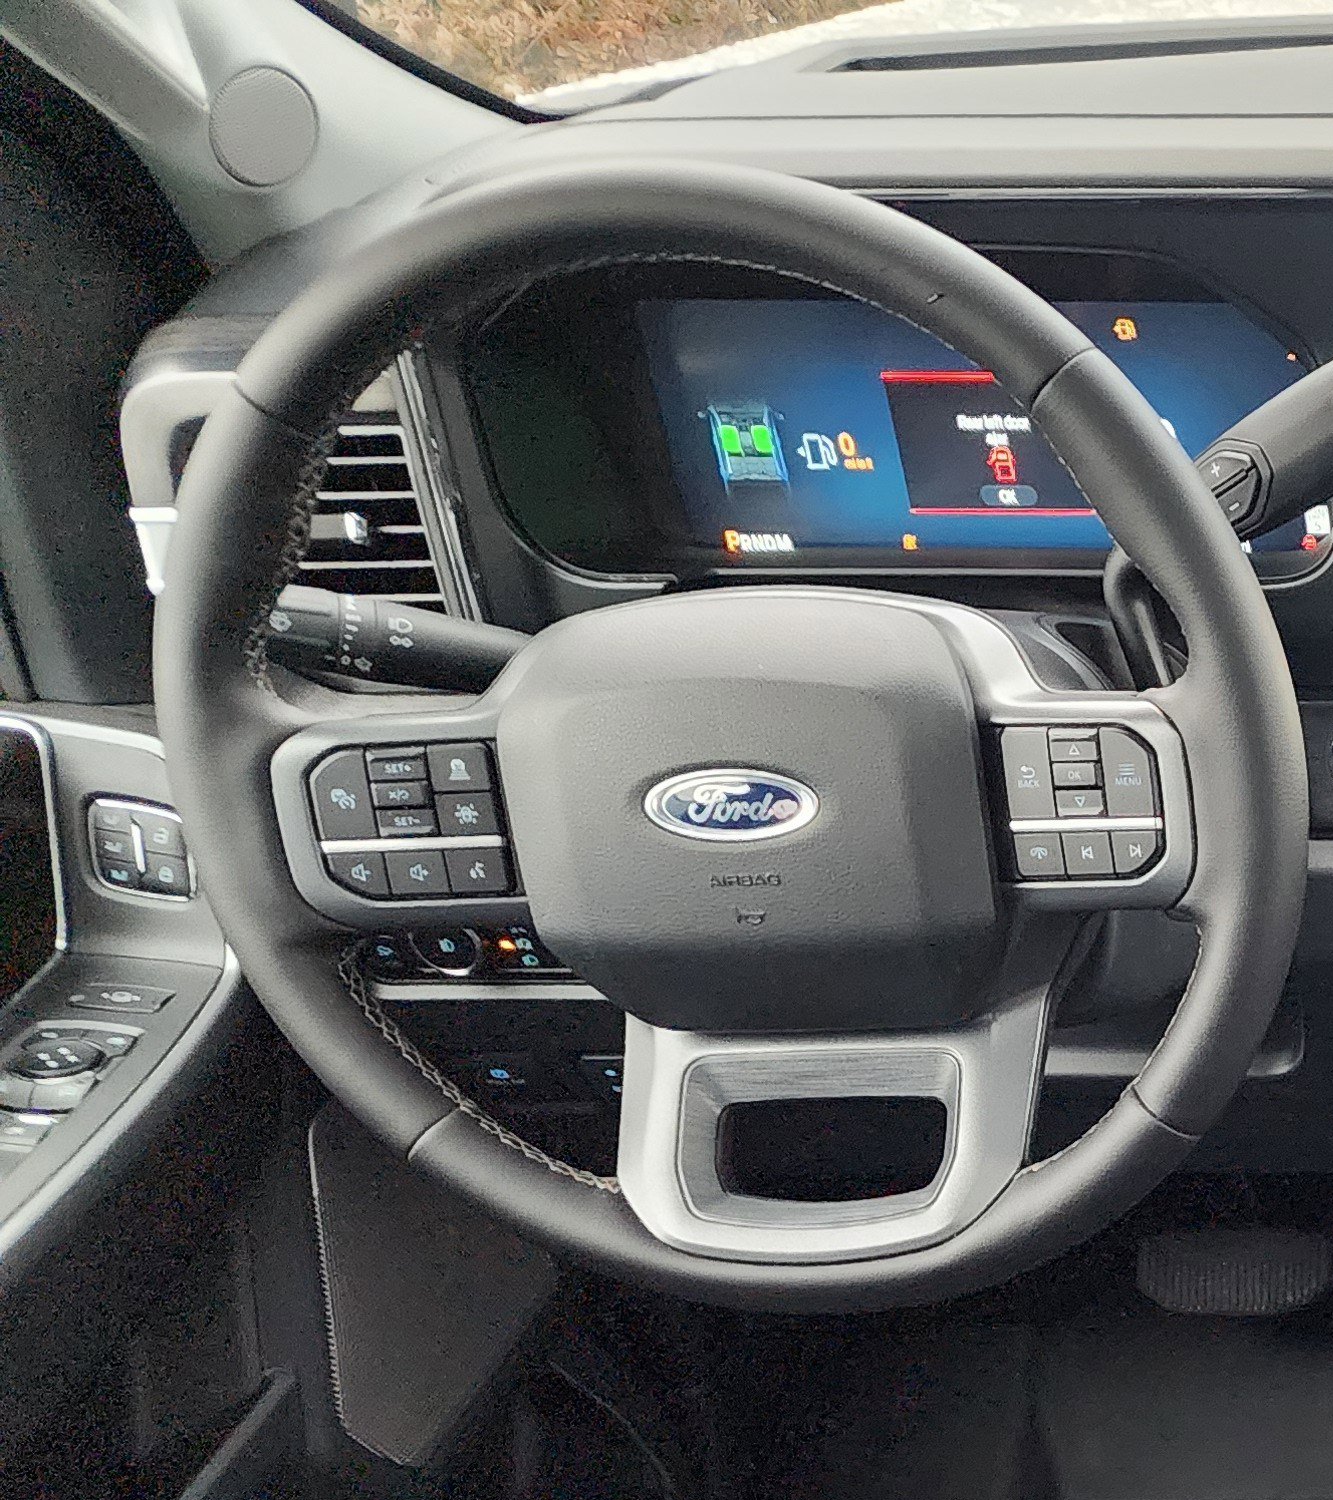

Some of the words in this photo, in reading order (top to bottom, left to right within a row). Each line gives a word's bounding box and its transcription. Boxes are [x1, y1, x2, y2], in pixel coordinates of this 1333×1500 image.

[1067, 770, 1082, 780] OK
[1017, 779, 1041, 789] BACK
[1114, 776, 1142, 787] MENU
[687, 782, 774, 824] Ford
[709, 874, 783, 888] AIRBAG
